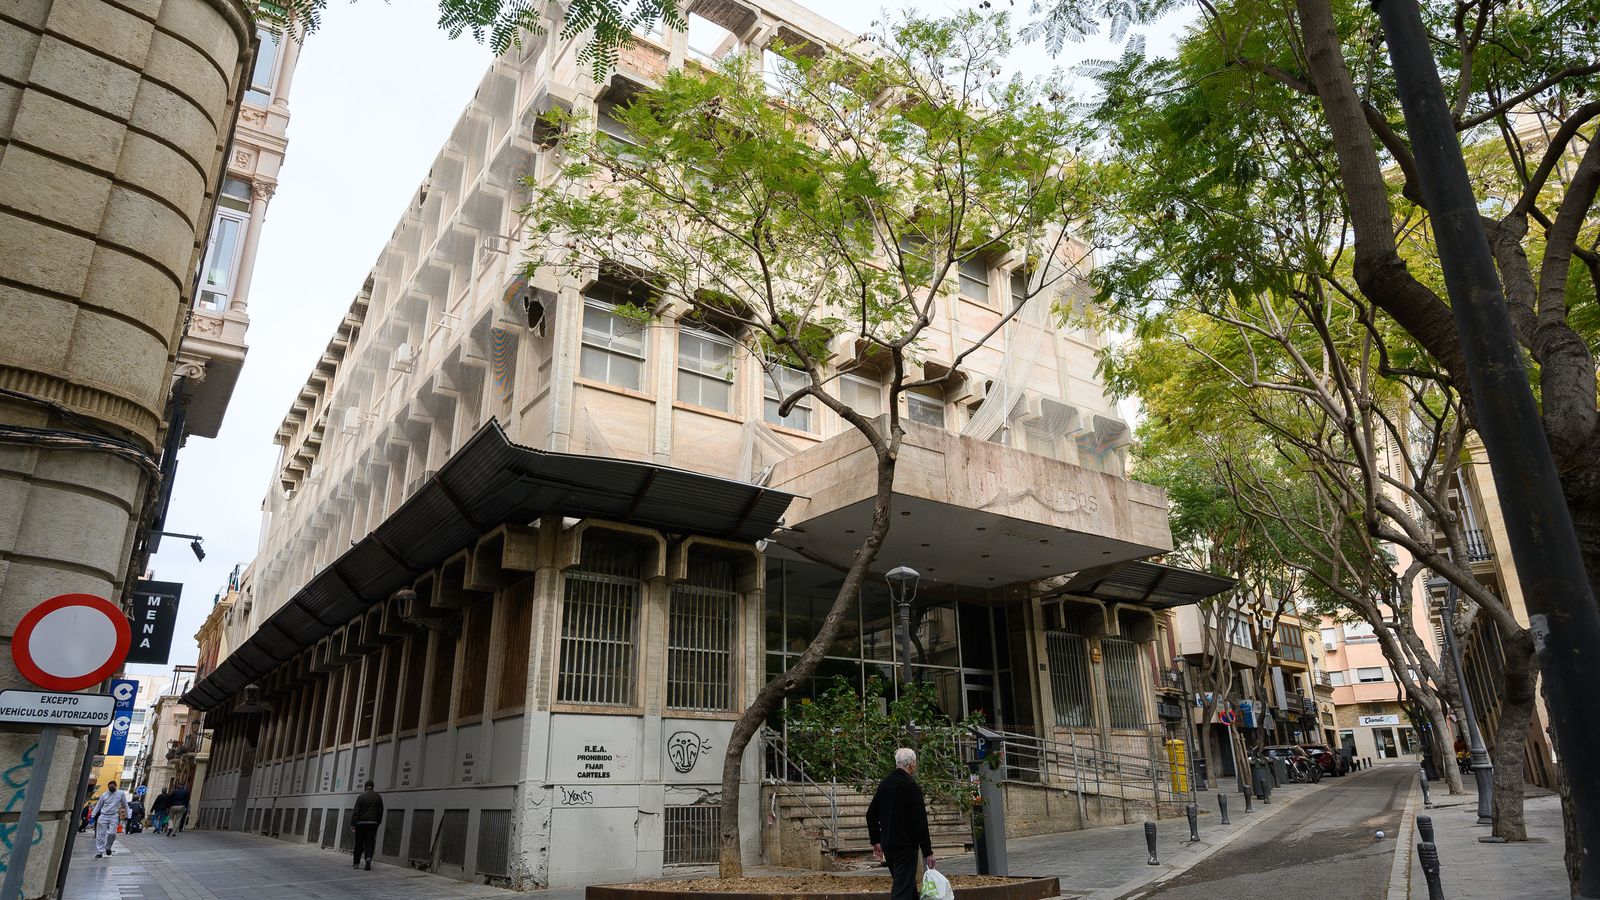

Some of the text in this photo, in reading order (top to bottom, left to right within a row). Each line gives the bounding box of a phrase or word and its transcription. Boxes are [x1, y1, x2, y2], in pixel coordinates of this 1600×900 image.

[140, 596, 161, 648] MENA
[40, 695, 79, 705] EXCEPTO
[116, 700, 131, 708] OPE
[0, 706, 109, 720] VEHÍCULOS AUTORIZADOS
[584, 745, 607, 753] R.E.A.
[978, 738, 985, 750] P
